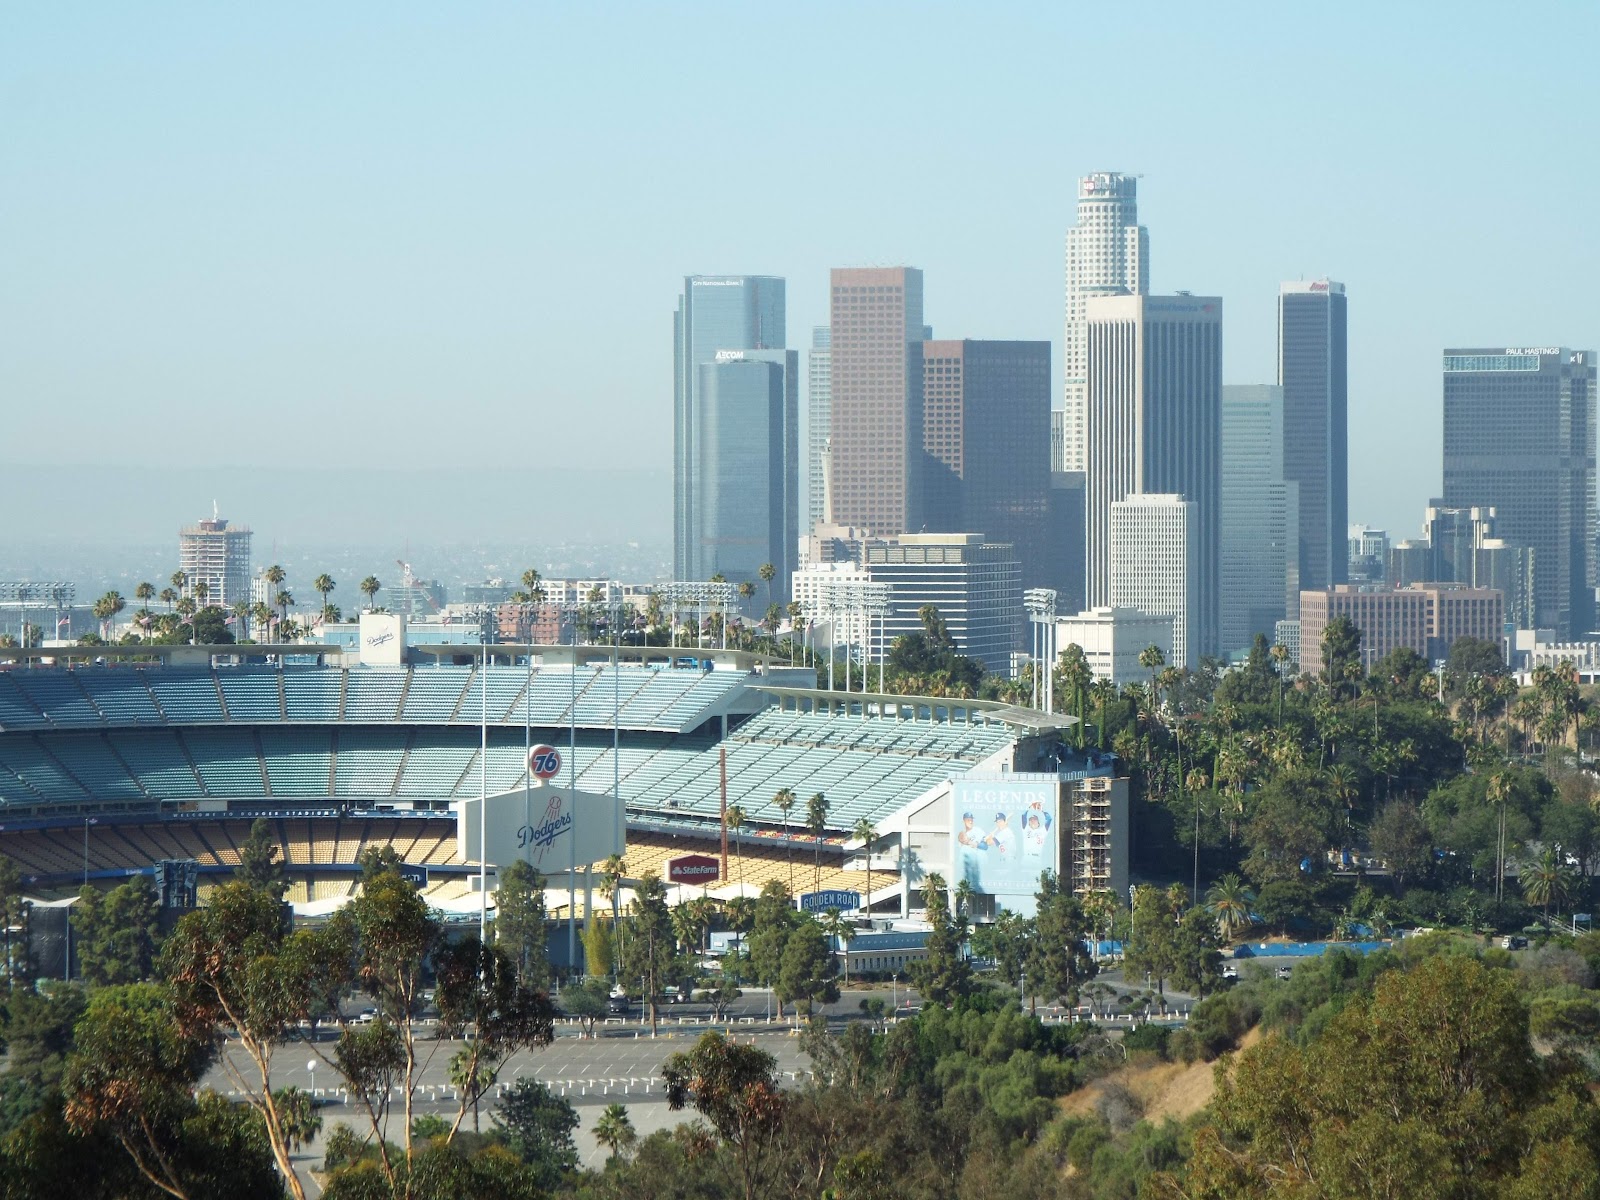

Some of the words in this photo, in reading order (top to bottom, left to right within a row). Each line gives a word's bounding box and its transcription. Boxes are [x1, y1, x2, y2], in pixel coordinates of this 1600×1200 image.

[714, 351, 744, 360] AECOM
[1505, 347, 1523, 355] PAUL
[1524, 347, 1560, 355] HASTINGS
[366, 632, 395, 647] Dodgers
[533, 752, 559, 773] 76
[961, 789, 1047, 804] LEGENDS
[517, 812, 572, 849] Dodgers
[803, 893, 835, 909] GOLDEN
[837, 893, 858, 907] ROAD
